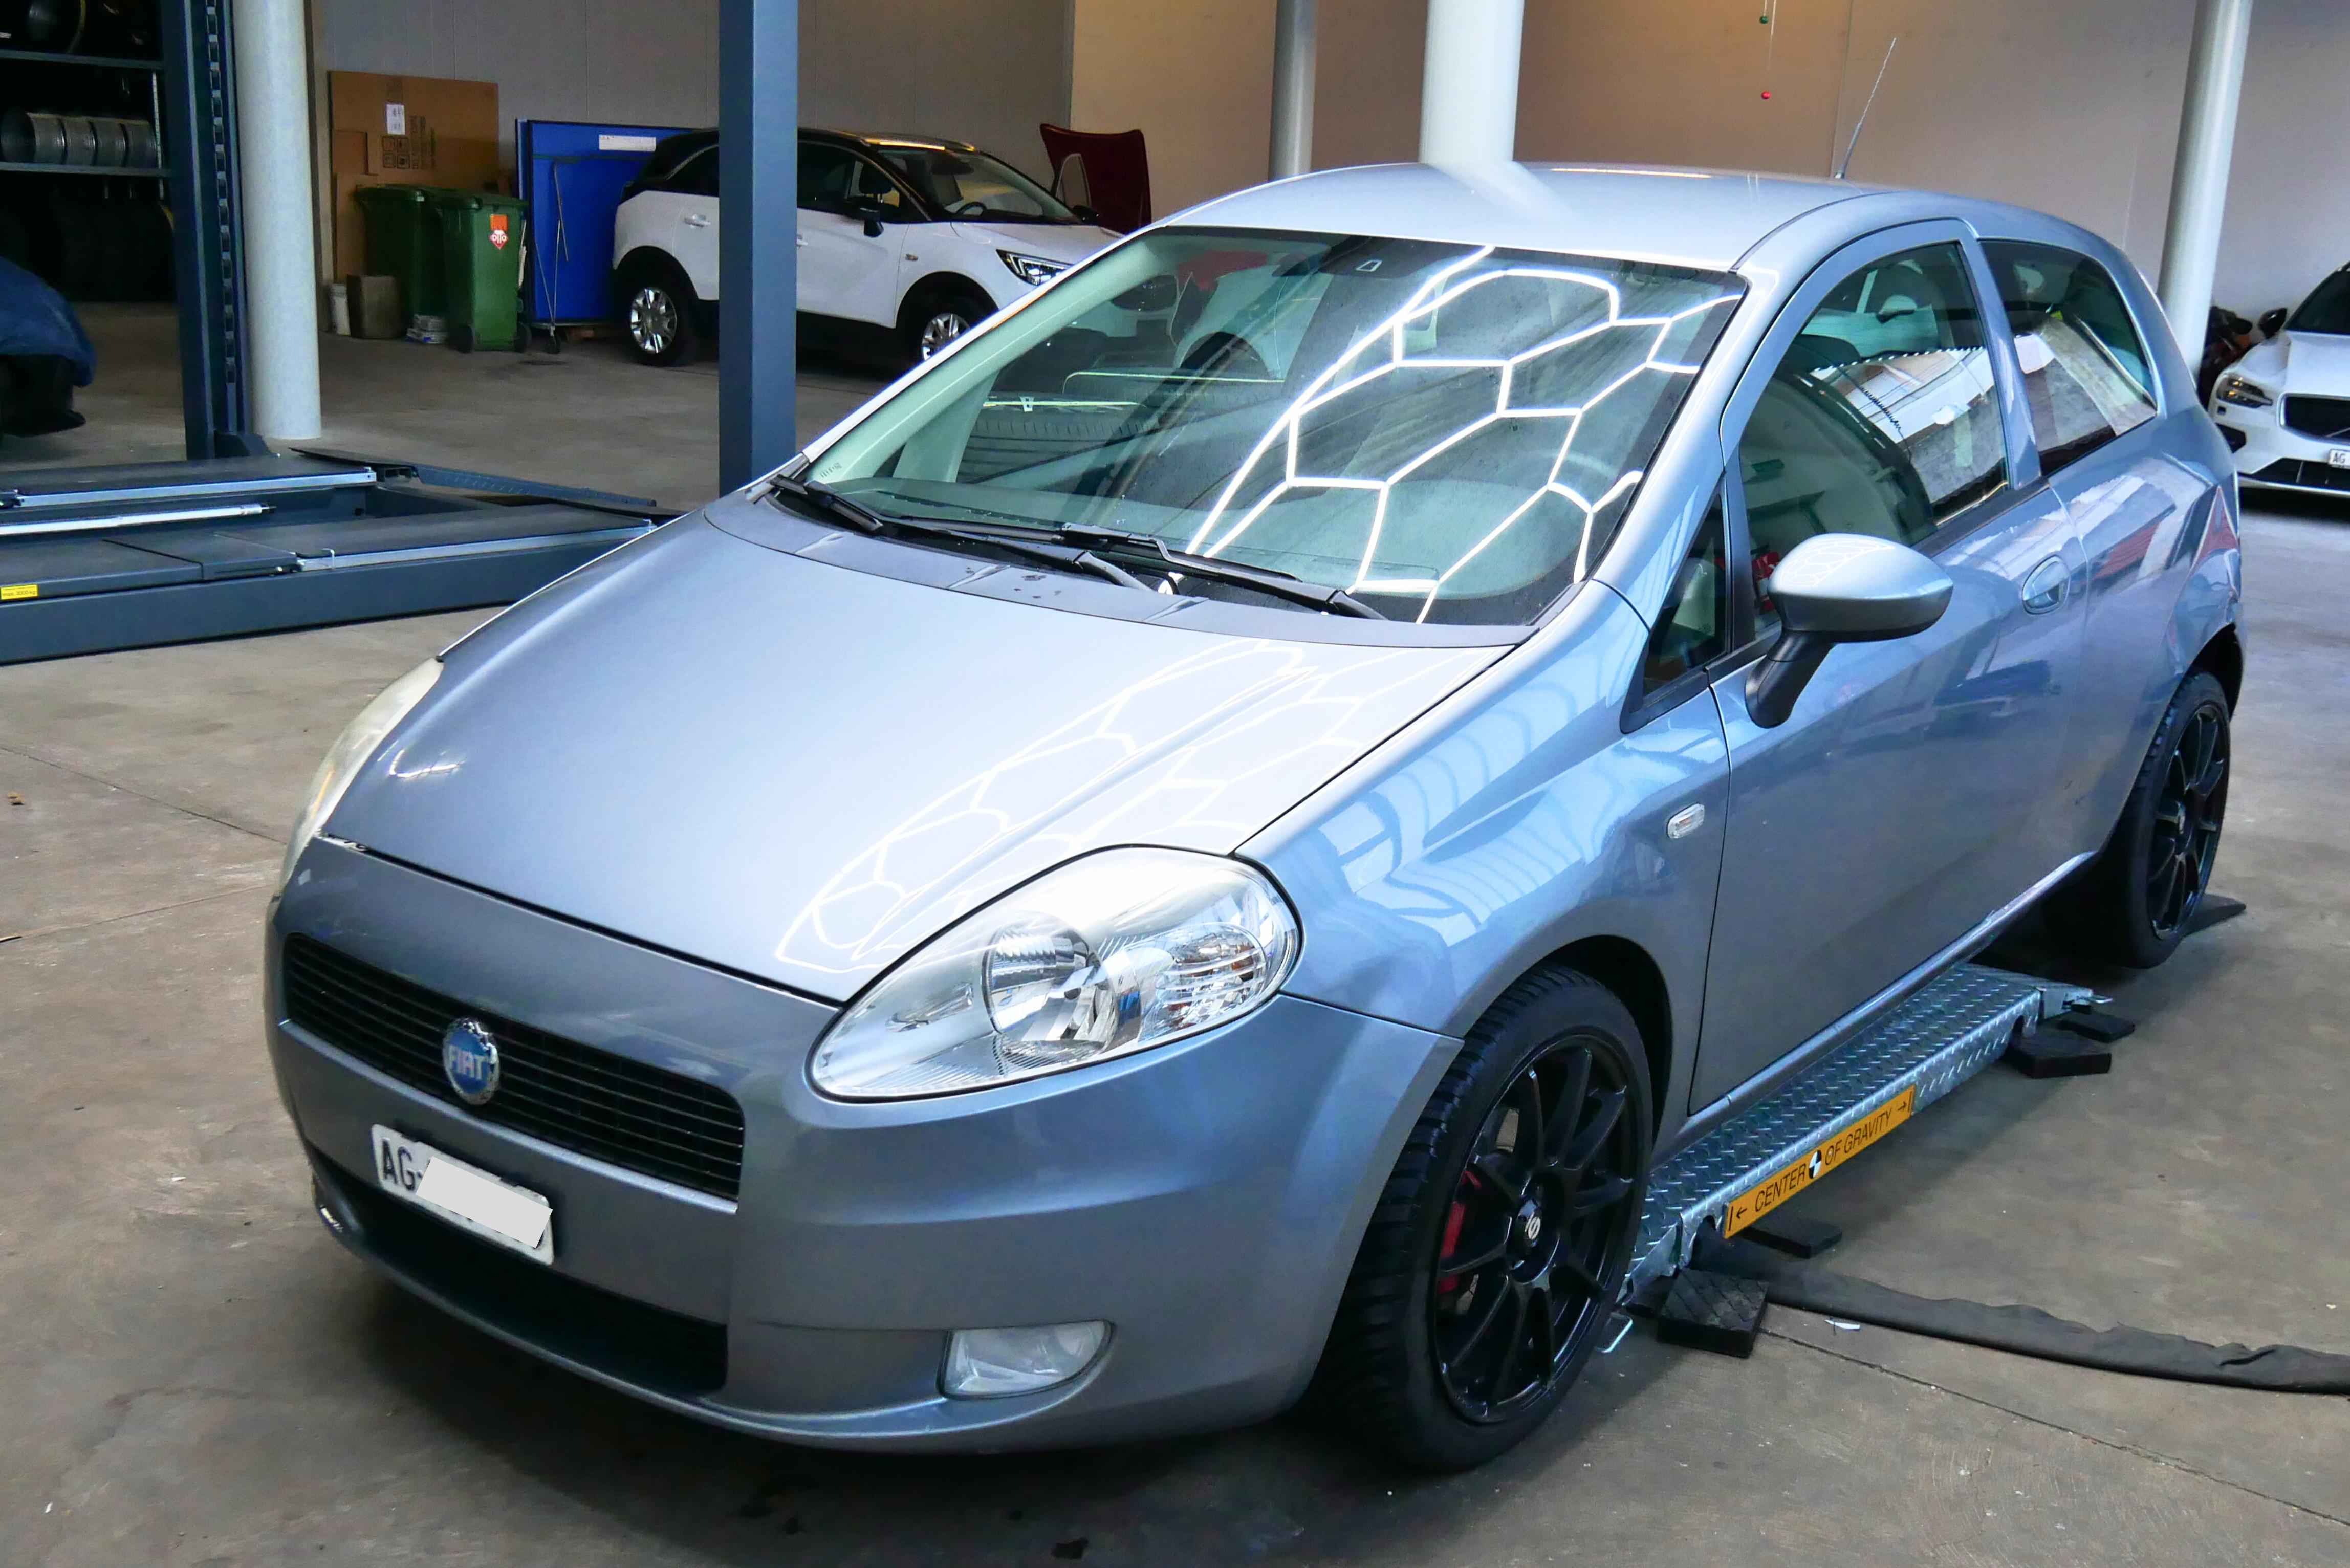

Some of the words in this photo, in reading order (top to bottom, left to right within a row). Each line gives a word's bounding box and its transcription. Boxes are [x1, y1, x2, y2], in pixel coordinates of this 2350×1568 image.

[2333, 452, 2345, 463] AG
[449, 1044, 489, 1080] FIAT
[1755, 1163, 1807, 1212] CENTER
[1825, 1139, 1842, 1165] OF
[1844, 1108, 1892, 1153] GRAVITY
